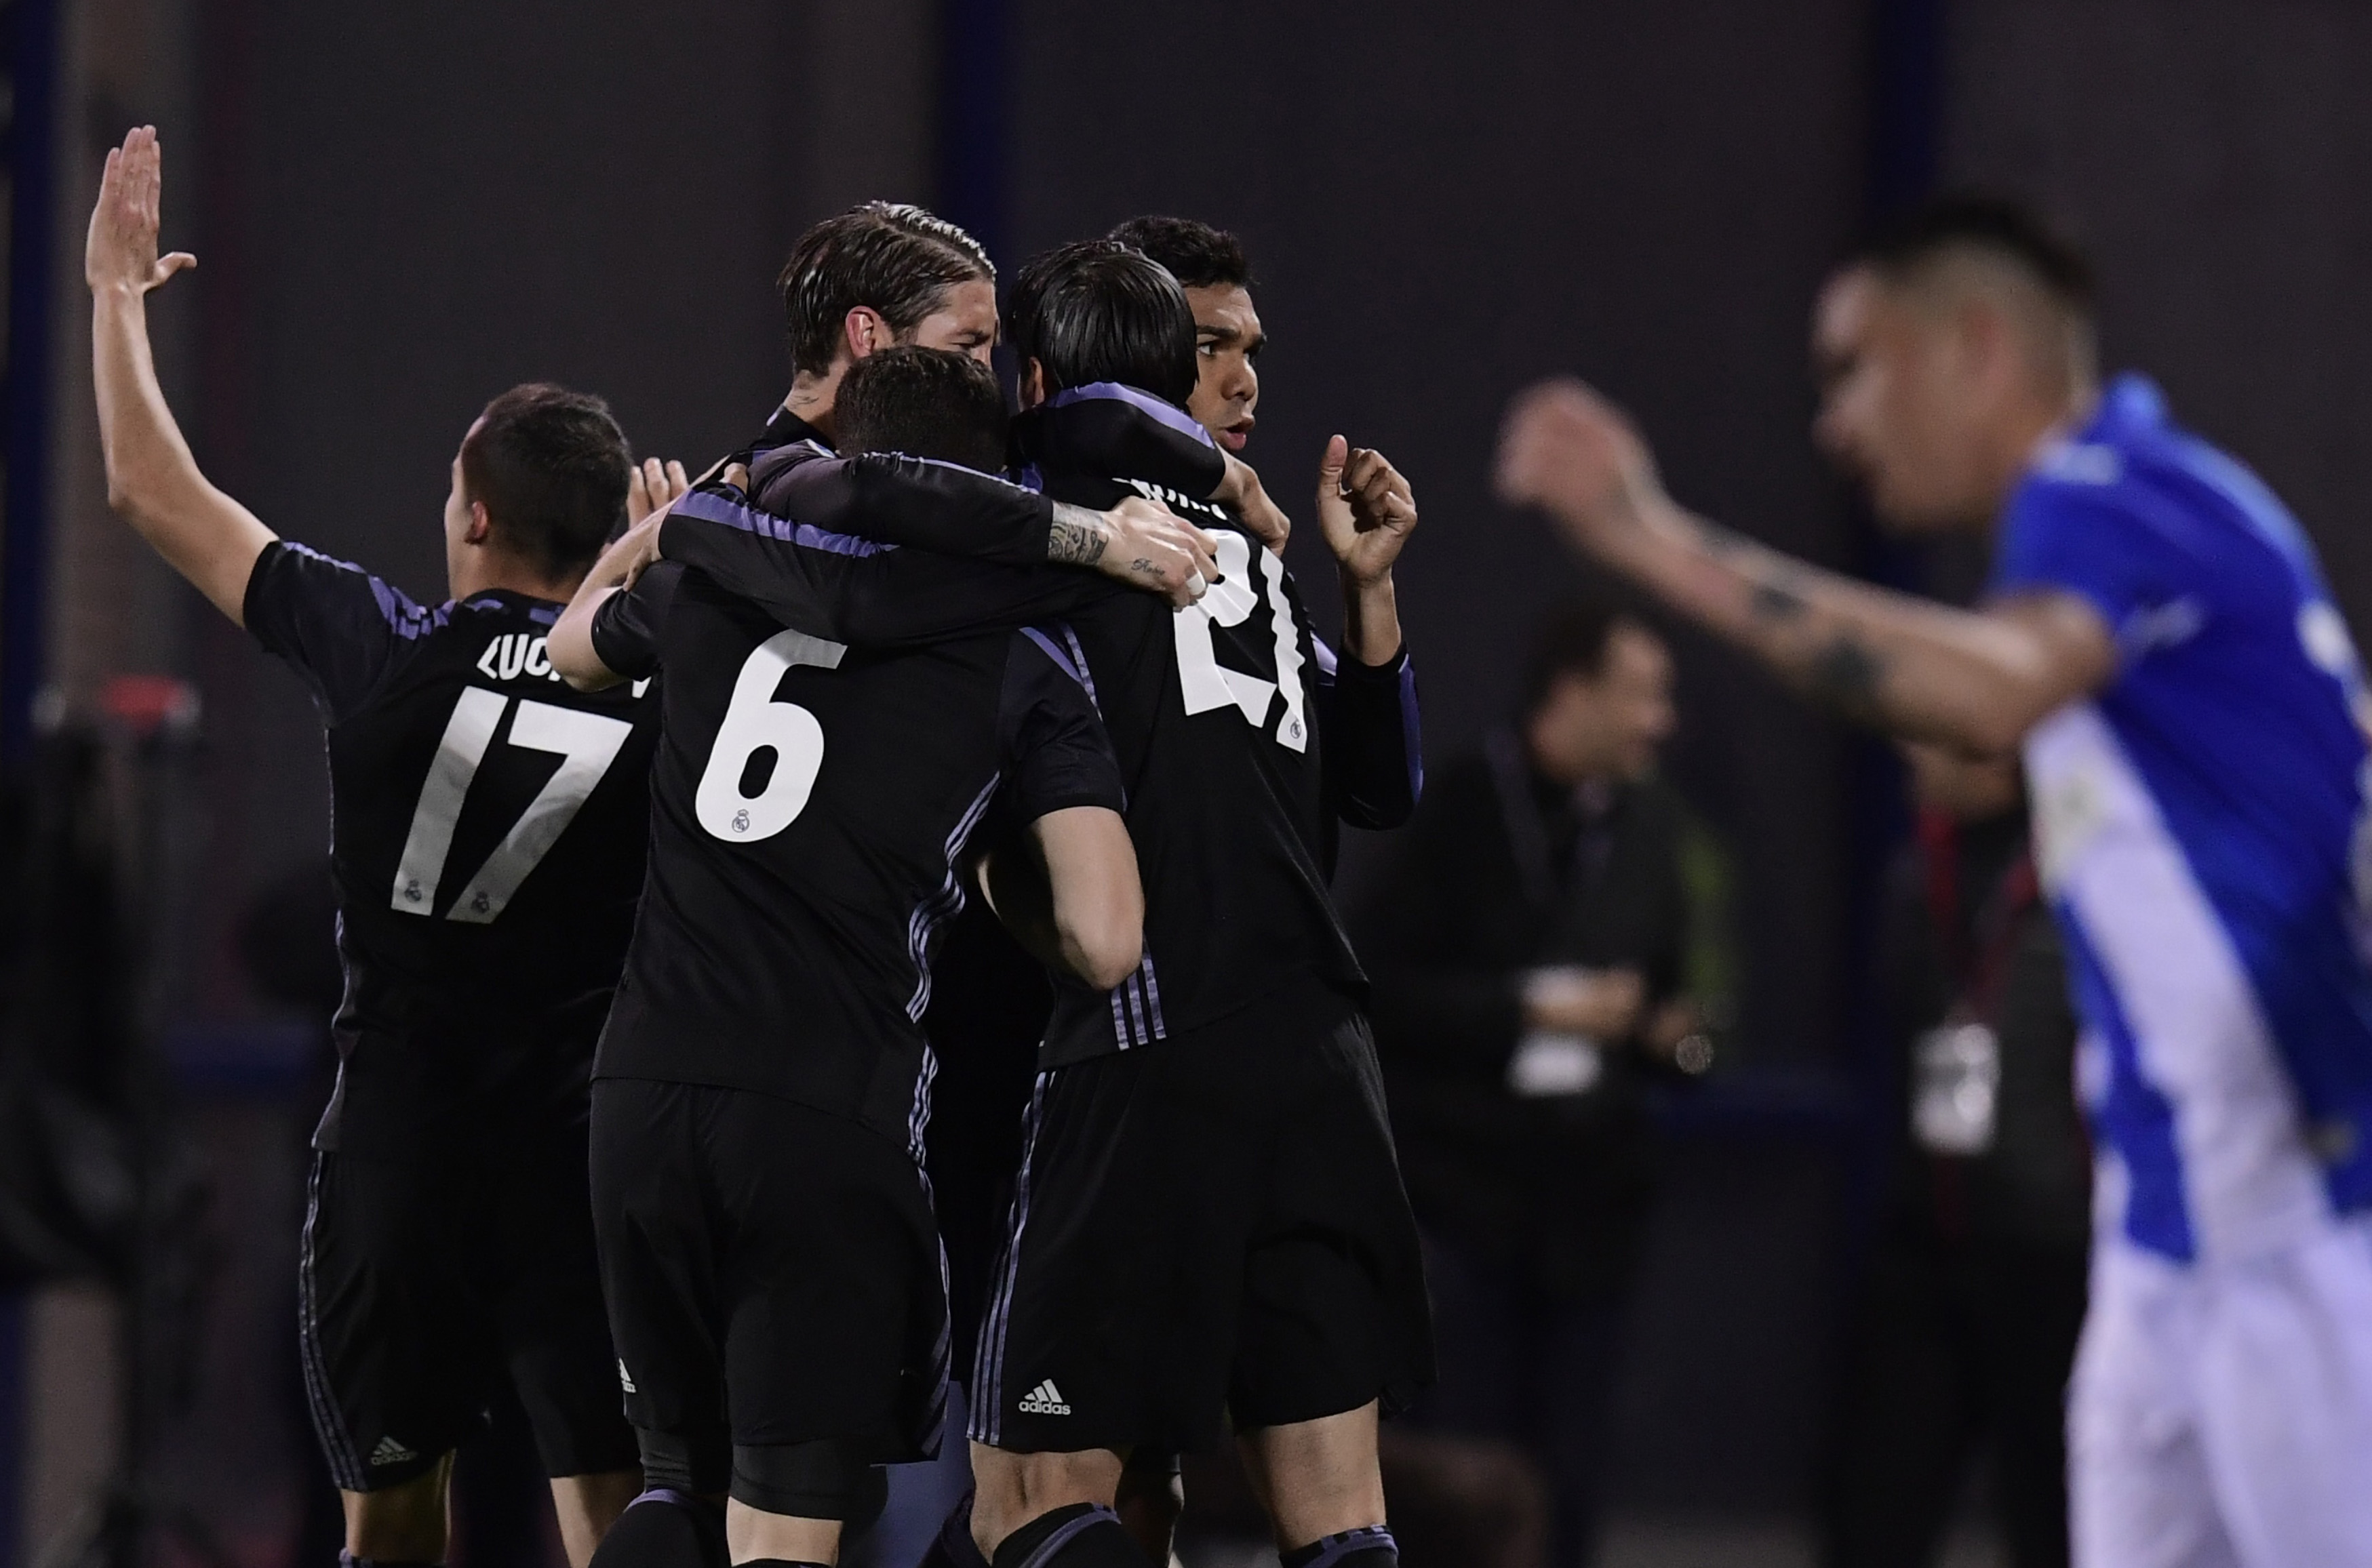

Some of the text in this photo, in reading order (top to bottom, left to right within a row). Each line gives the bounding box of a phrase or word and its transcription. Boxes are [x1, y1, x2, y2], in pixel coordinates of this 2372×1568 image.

[477, 633, 561, 682] LUC
[695, 628, 848, 843] 6
[1172, 528, 1308, 755] 21
[391, 685, 634, 924] 17
[1019, 1400, 1071, 1415] adidas
